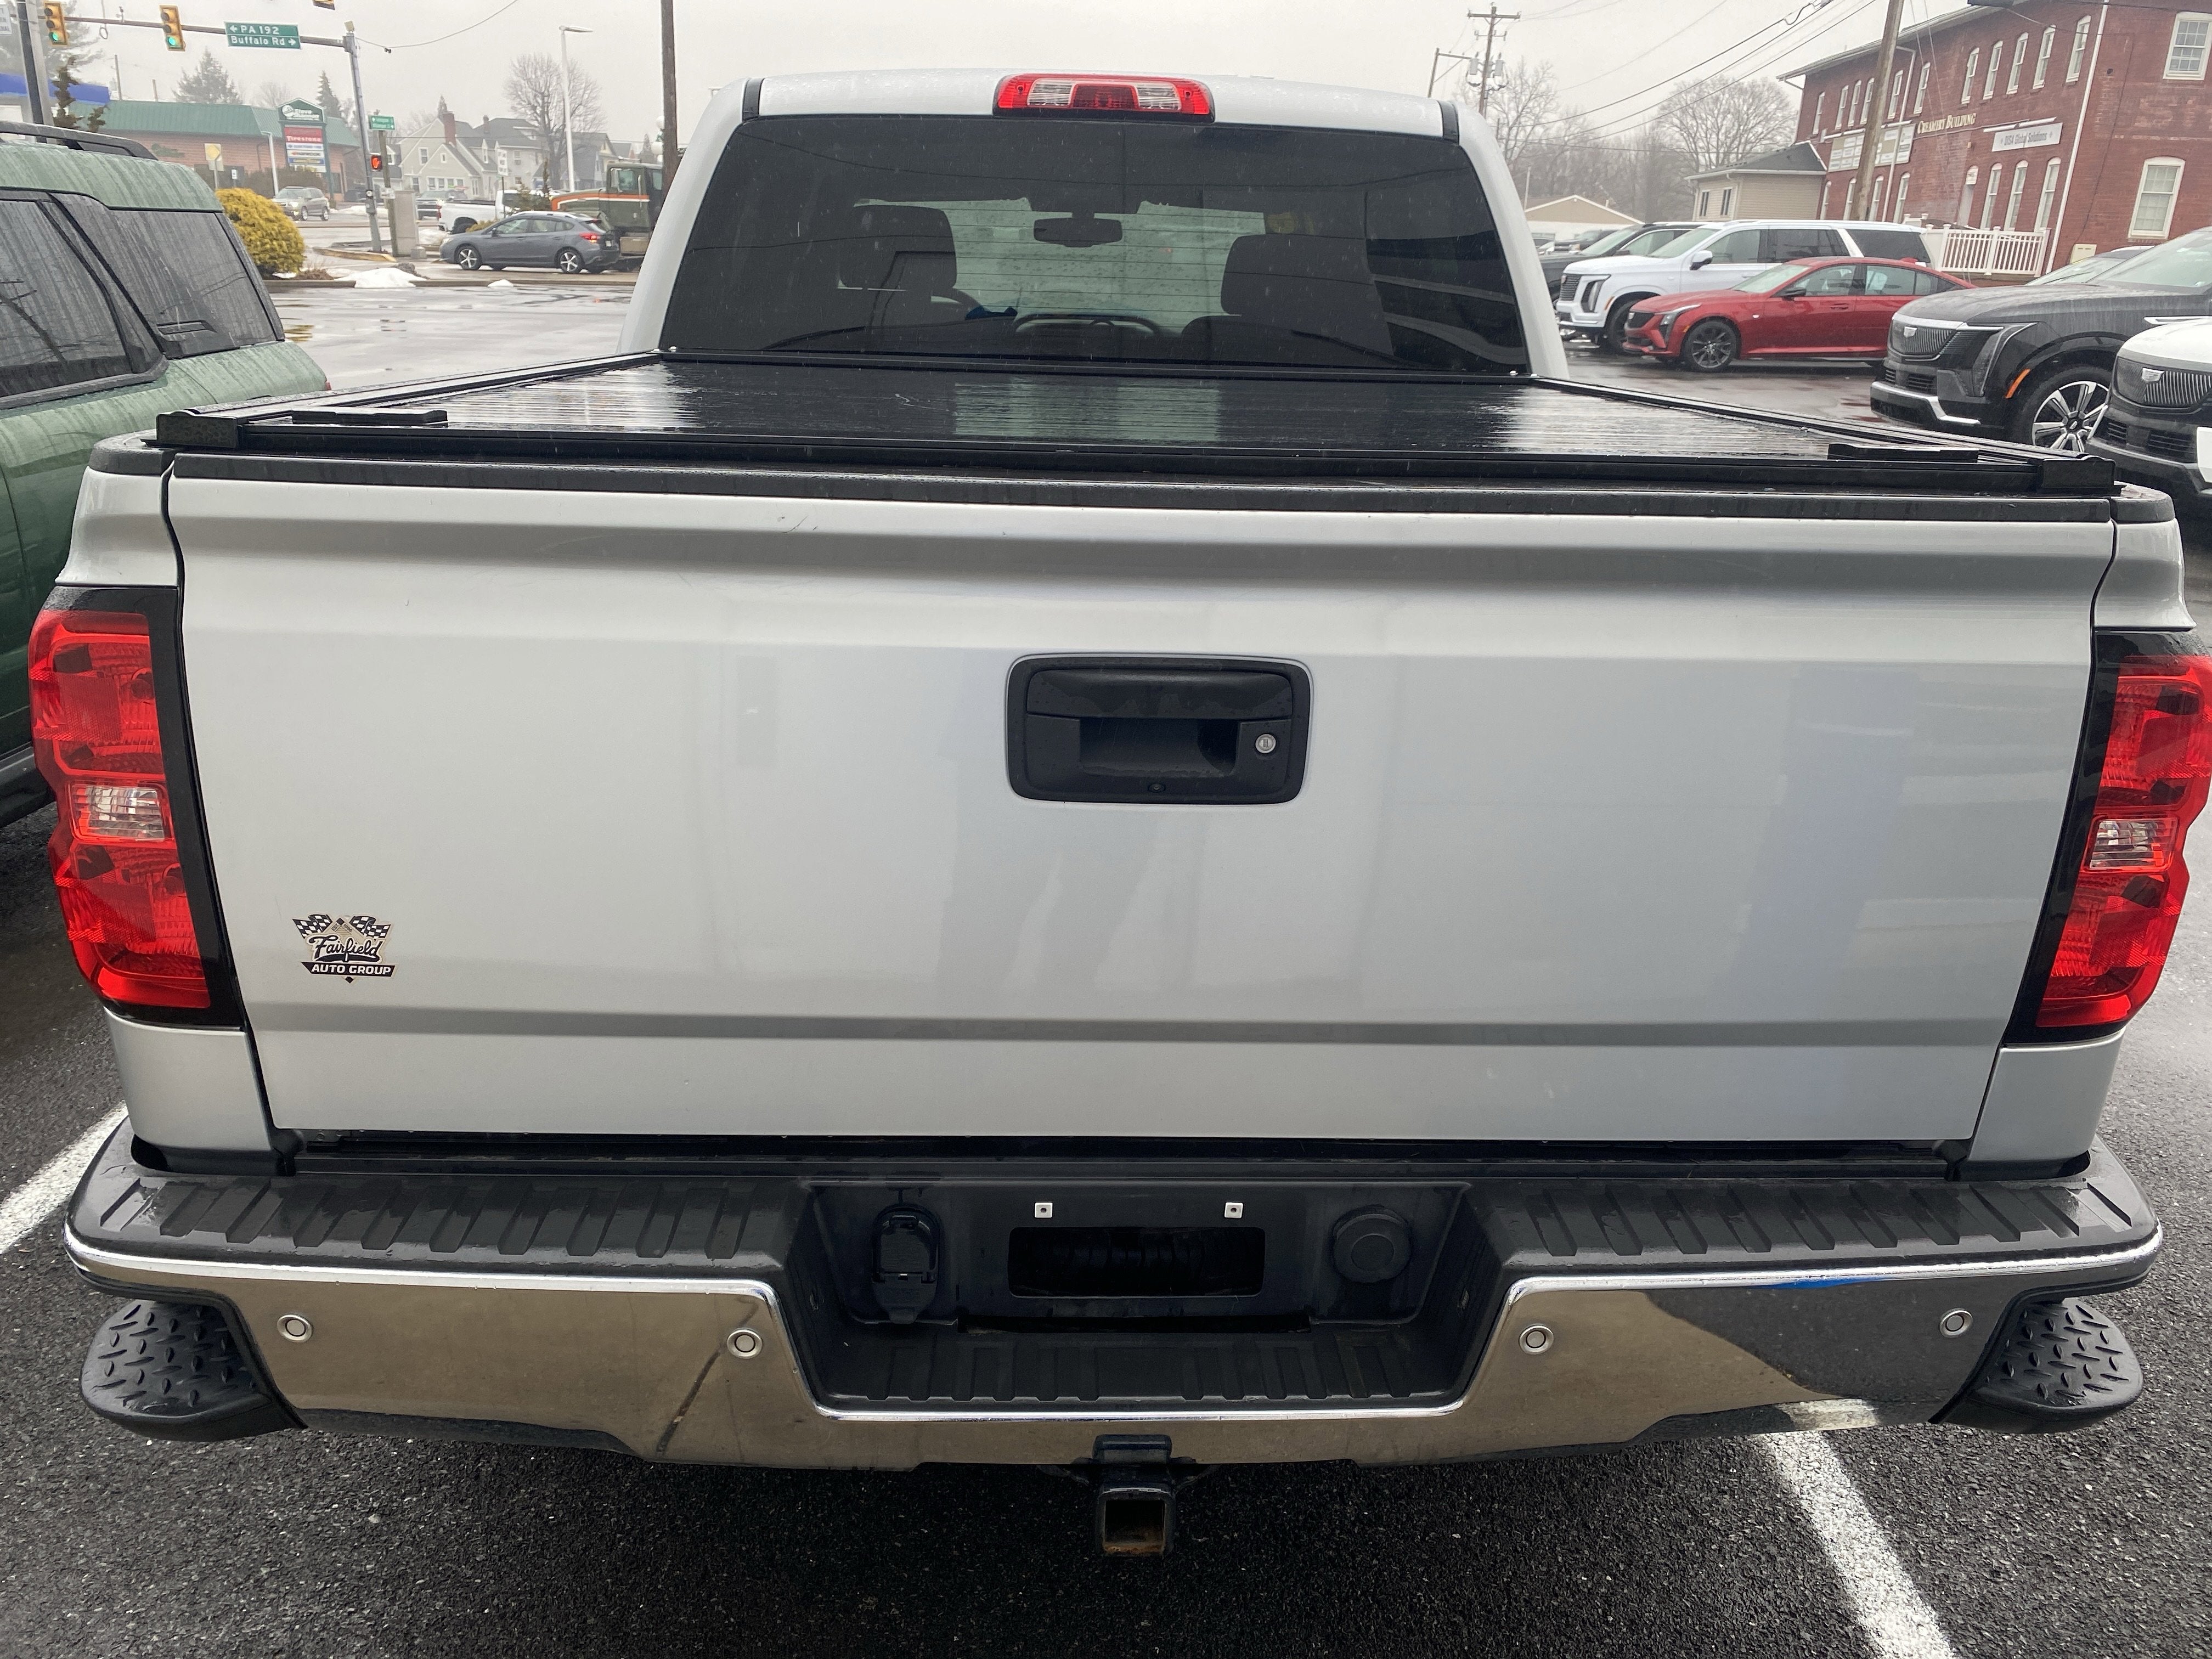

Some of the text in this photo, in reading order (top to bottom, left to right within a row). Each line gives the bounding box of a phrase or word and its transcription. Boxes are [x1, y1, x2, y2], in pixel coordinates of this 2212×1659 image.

[240, 25, 279, 35] PA 192
[230, 36, 269, 45] Buffalo
[1945, 115, 1976, 129] BUILDING
[308, 935, 383, 962] Fairfield
[311, 964, 391, 975] AUTO GROUP
